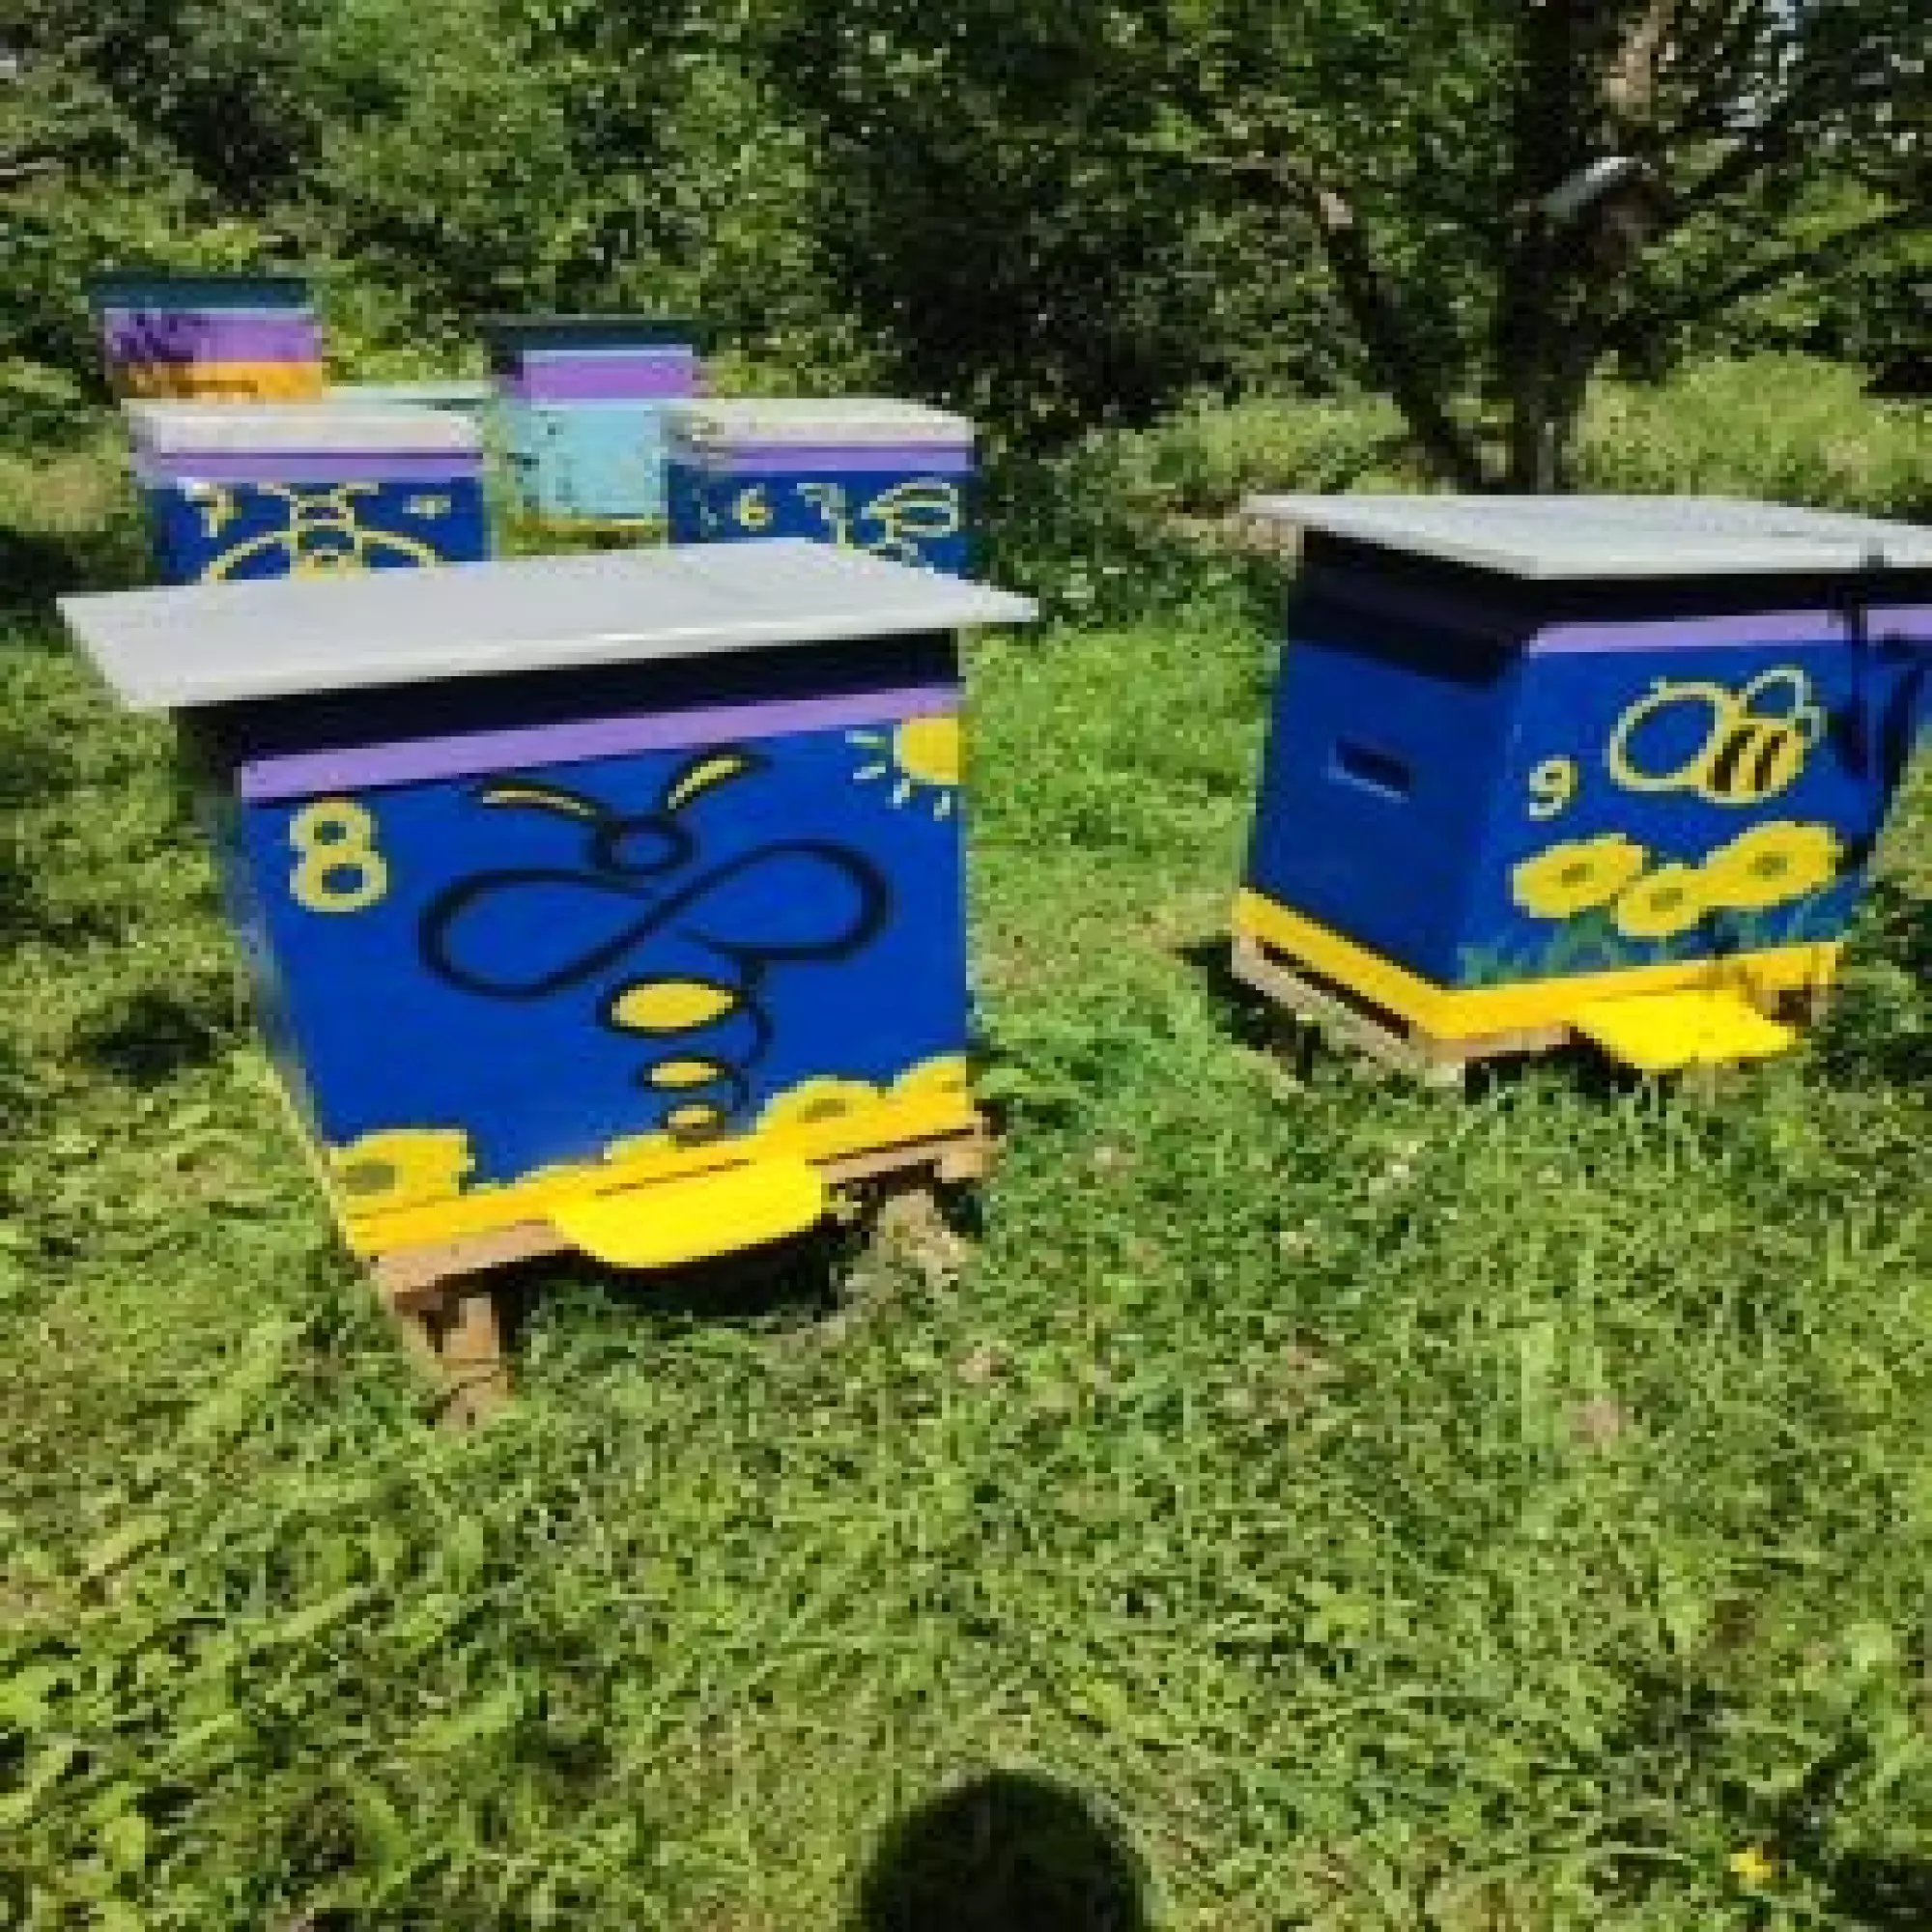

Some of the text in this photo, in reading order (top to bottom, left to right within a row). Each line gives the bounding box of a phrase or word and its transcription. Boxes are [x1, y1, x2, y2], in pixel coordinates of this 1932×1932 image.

[733, 488, 773, 530] 6
[1528, 756, 1578, 820] 9
[290, 797, 386, 912] 8
